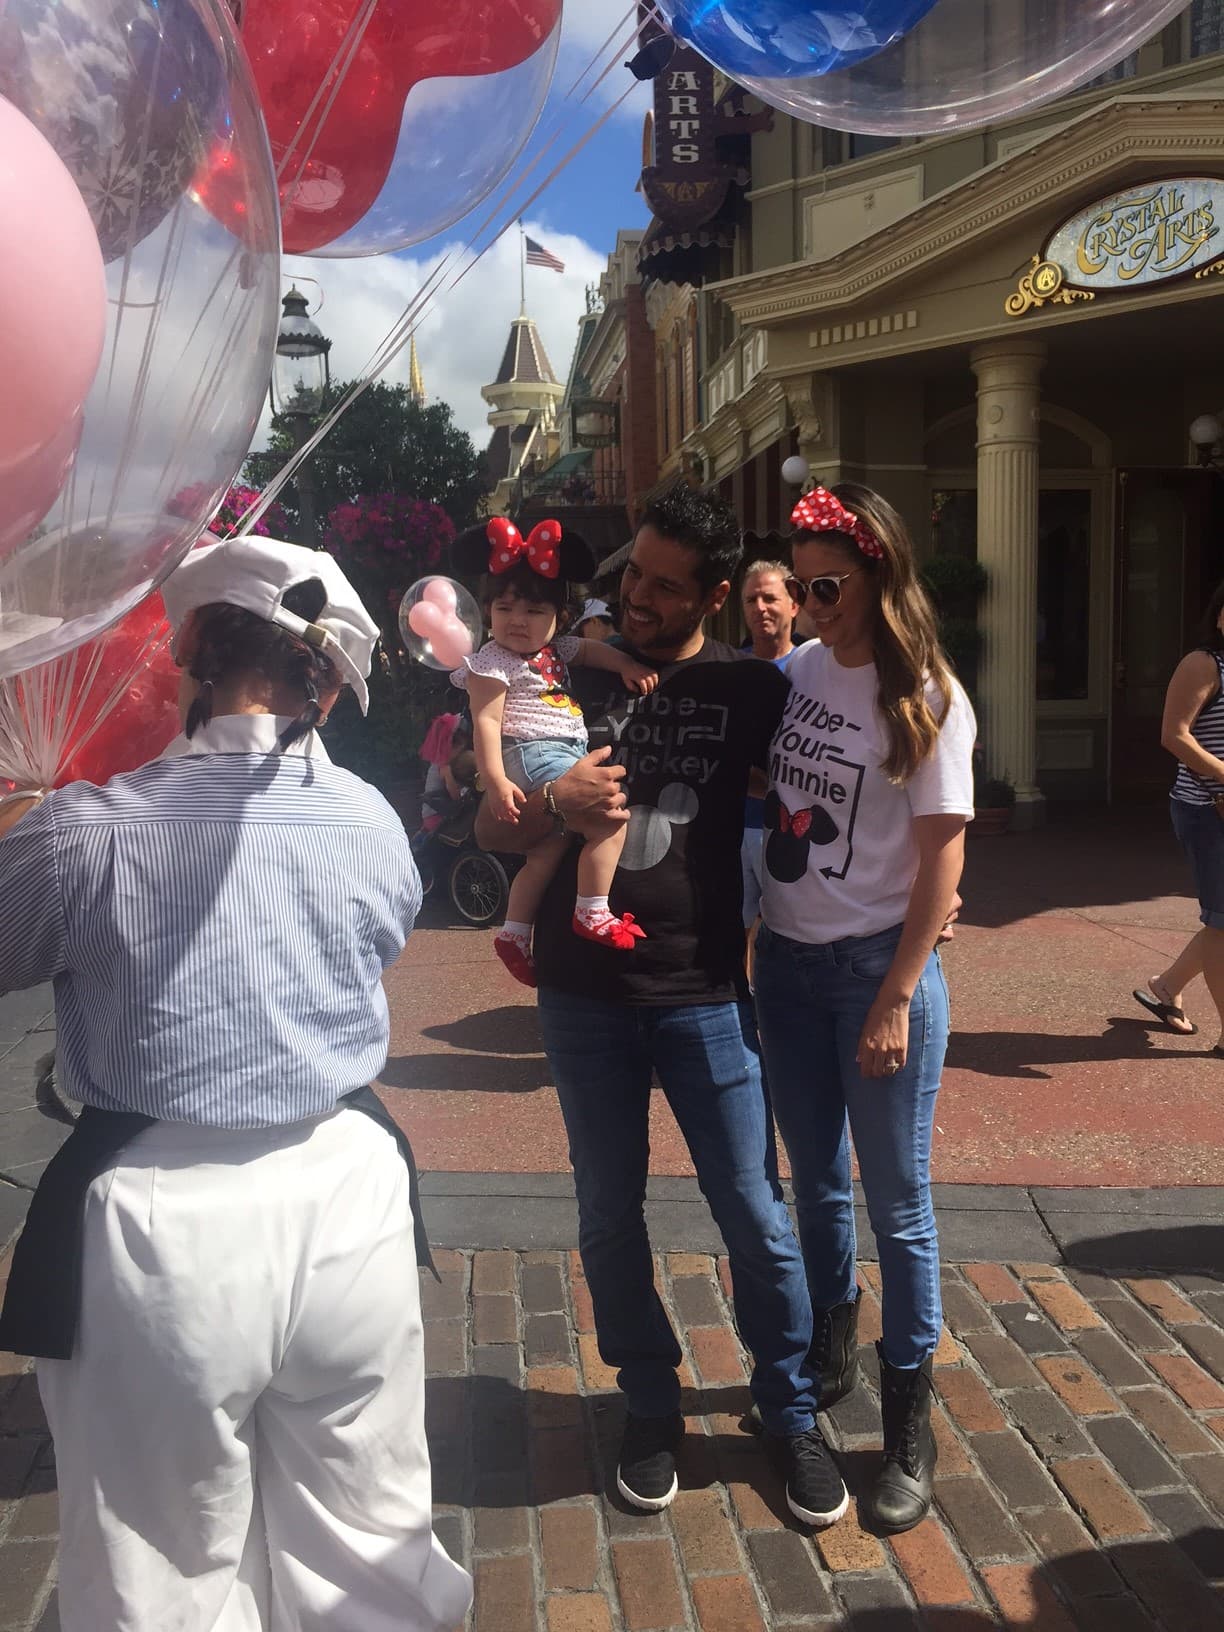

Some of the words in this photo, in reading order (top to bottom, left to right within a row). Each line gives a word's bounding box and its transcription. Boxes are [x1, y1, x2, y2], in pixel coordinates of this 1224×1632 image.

[668, 71, 700, 164] ARTS
[1076, 186, 1186, 276] CRYSTAL
[1117, 200, 1220, 281] ARTS
[651, 691, 697, 716] be
[810, 703, 844, 733] be
[607, 715, 690, 746] Your
[773, 721, 830, 762] Your
